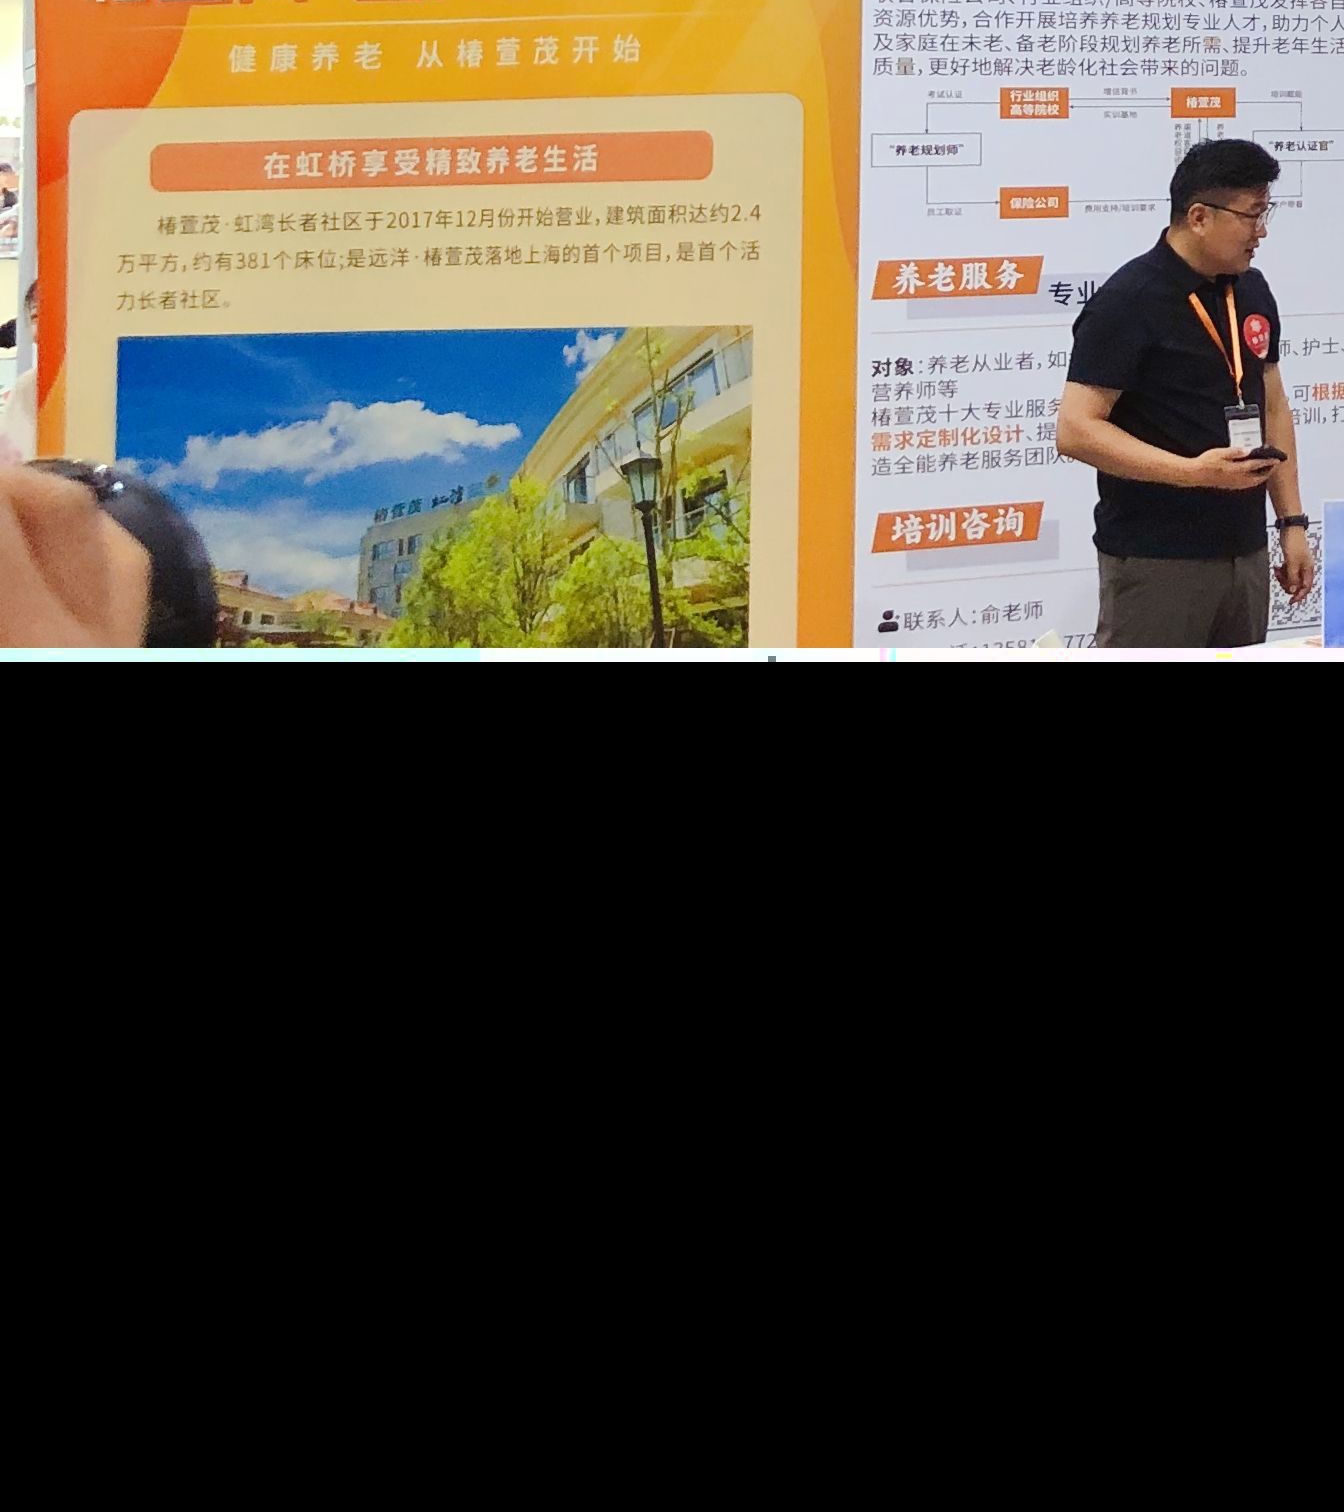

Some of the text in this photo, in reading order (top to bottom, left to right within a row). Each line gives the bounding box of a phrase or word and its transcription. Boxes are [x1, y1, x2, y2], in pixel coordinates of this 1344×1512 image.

[228, 33, 643, 75] 健康养老 从椿萱茂开始
[872, 56, 1249, 78] 质量，更好地解决老龄化社会带来的问题。
[1009, 89, 1060, 101] 行业组织
[1186, 96, 1222, 109] 椿萱茂
[1009, 103, 1060, 116] 高等院校
[263, 142, 599, 182] 在虹桥享受精致养老生活
[1009, 196, 1059, 209] 保险公司
[891, 260, 1026, 295] 养老服务
[116, 287, 233, 312] 力长者社区。
[1048, 280, 1099, 307] 专业
[871, 379, 959, 402] 营养师等
[891, 505, 1025, 545] 培训咨询
[903, 600, 1044, 631] 联系人：俞老师
